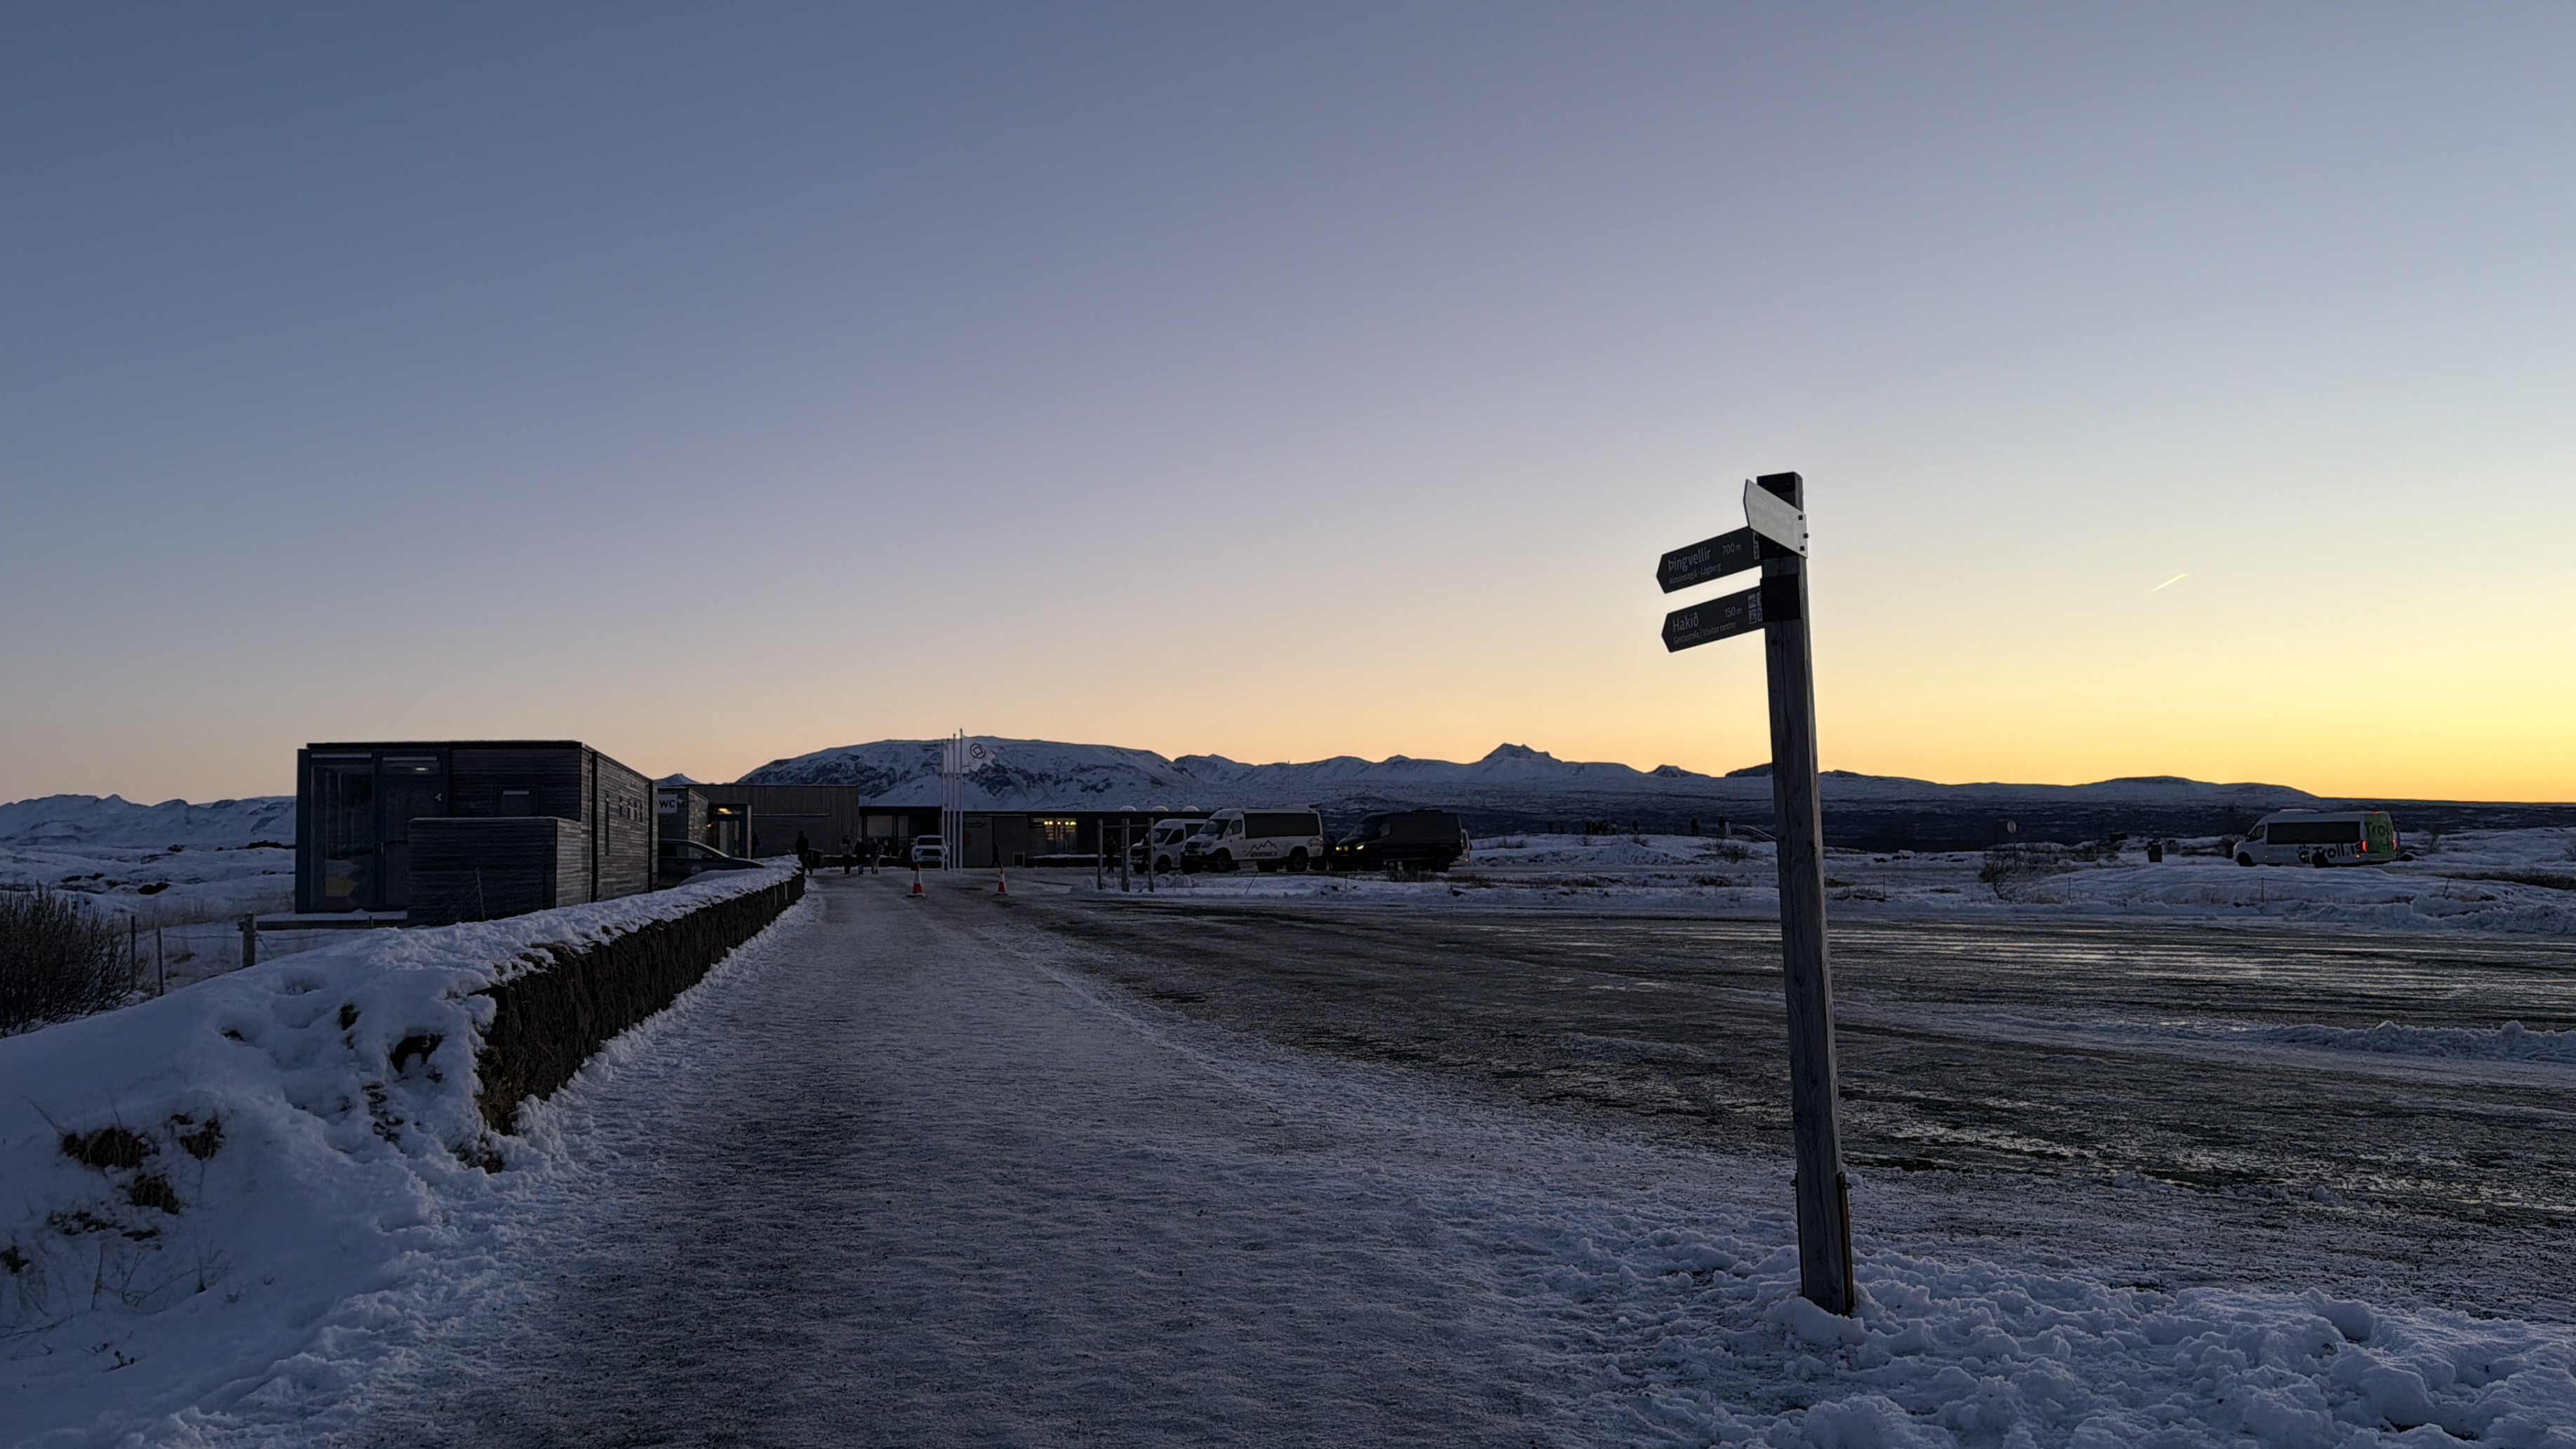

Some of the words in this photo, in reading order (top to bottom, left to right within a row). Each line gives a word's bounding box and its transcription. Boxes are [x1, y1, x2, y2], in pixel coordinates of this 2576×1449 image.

[1668, 546, 1712, 573] Þingvellir
[1672, 611, 1699, 633] Hakið
[1702, 626, 1720, 637] Visitor
[1719, 621, 1736, 632] centre
[659, 800, 676, 808] WC
